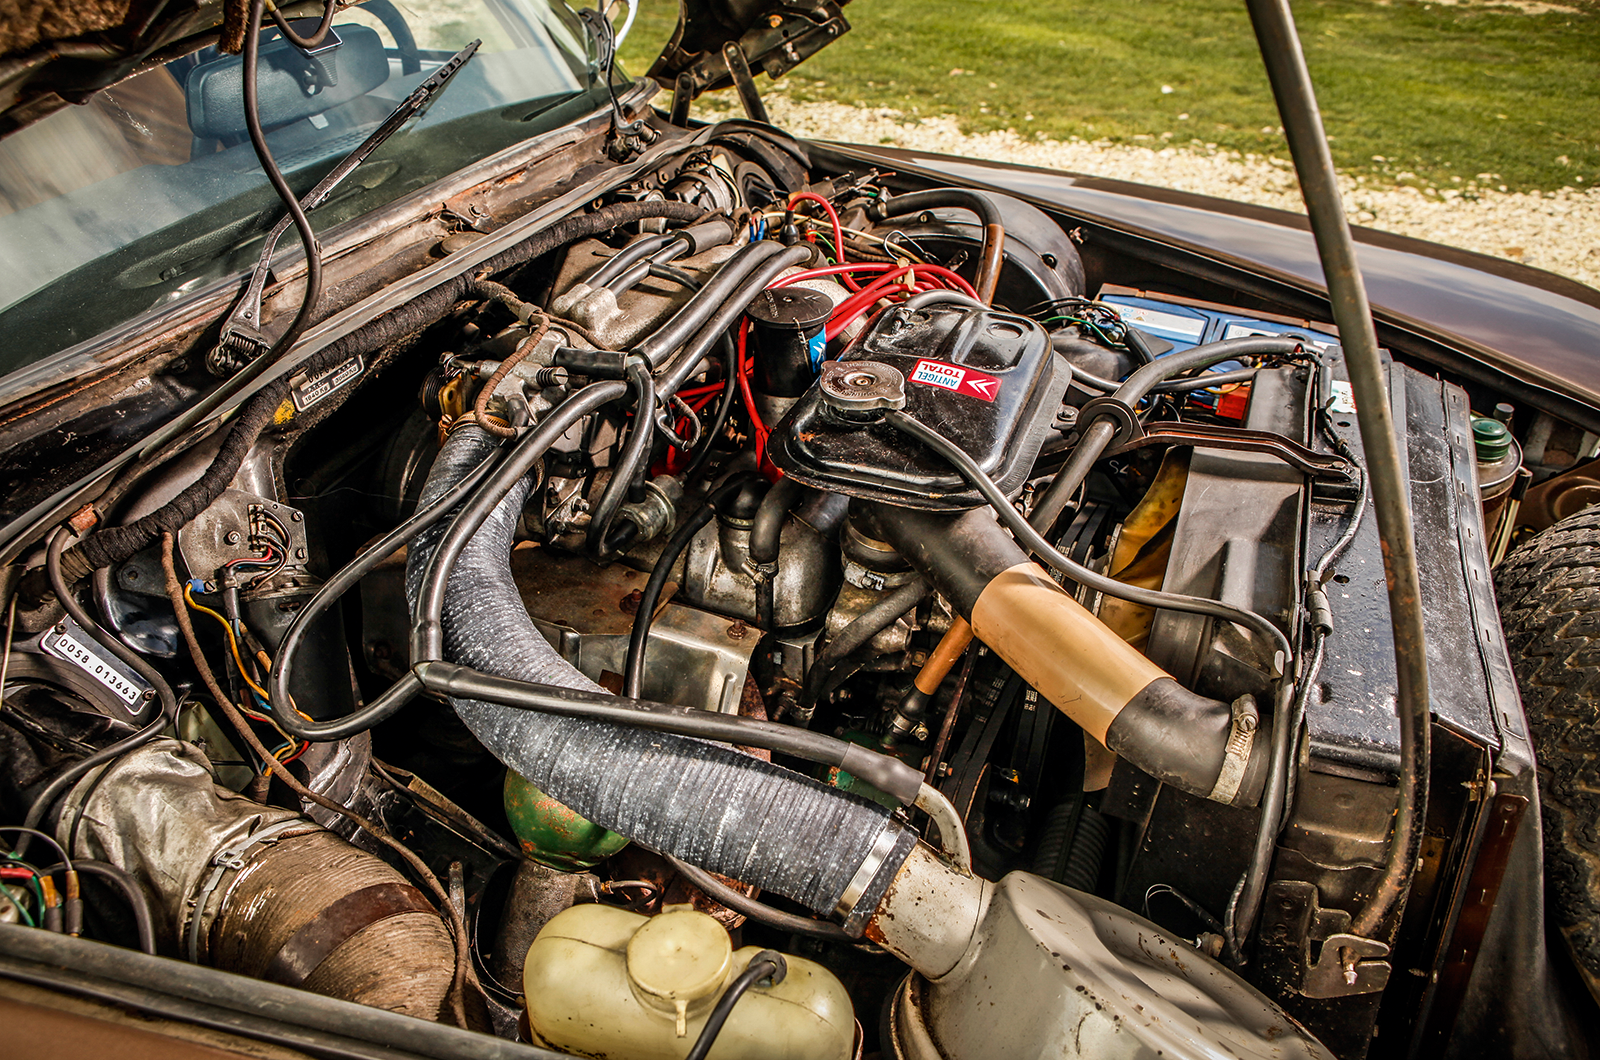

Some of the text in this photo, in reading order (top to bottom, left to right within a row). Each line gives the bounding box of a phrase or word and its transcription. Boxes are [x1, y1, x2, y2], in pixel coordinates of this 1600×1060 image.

[921, 363, 960, 378] TOTAL
[917, 371, 958, 387] ANTIGEL
[60, 638, 137, 700] 0058.013663
